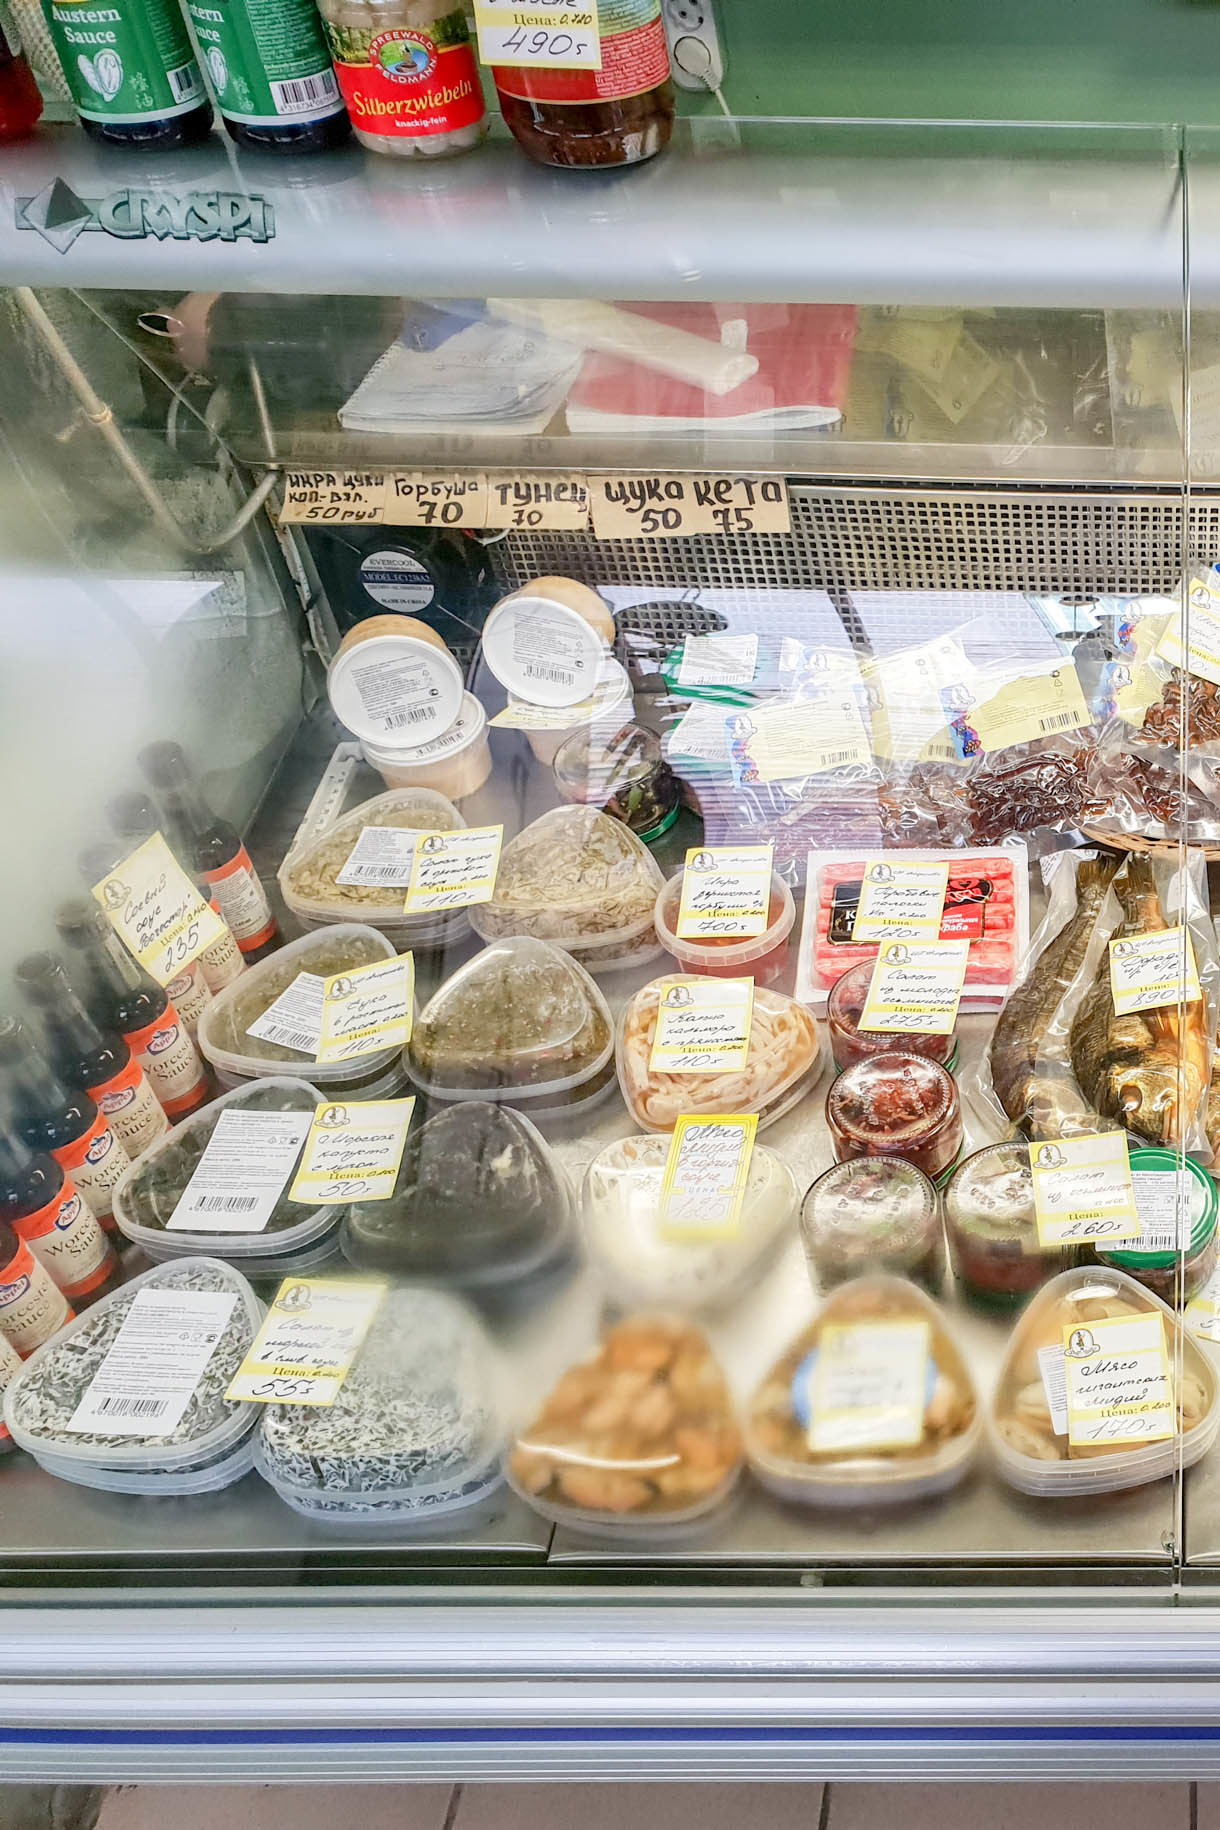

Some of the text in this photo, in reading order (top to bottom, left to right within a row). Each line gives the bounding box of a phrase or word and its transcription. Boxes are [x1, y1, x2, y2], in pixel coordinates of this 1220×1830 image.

[52, 5, 122, 23] Austern
[514, 14, 557, 26] Цена:
[64, 27, 117, 44] Sauce
[370, 31, 434, 55] SPREEWALD
[353, 79, 473, 116] Silberzwiebeln
[101, 190, 270, 243] CRYSPI
[287, 474, 336, 488] ИКРА
[418, 500, 464, 524] 70
[512, 509, 543, 526] 70
[641, 507, 682, 533] 50
[712, 507, 755, 534] 75
[165, 922, 200, 973] 235
[1081, 1360, 1138, 1376] Мясо
[1101, 1408, 1138, 1418] Цена:
